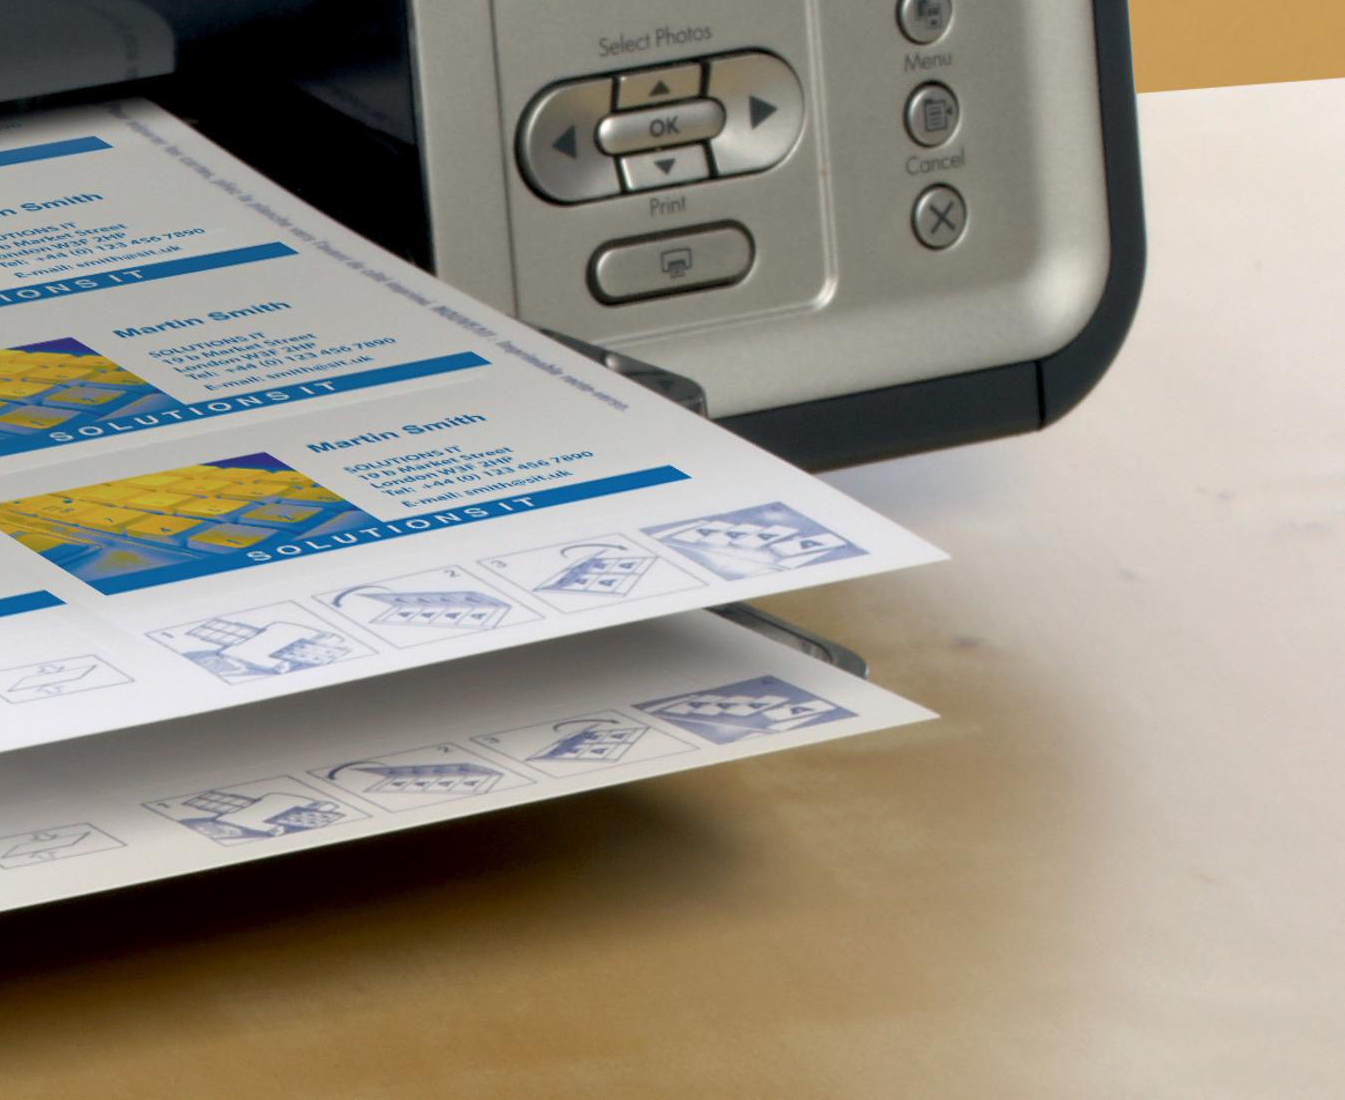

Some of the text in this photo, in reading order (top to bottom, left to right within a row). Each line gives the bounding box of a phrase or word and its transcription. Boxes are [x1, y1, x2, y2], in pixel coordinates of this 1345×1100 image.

[598, 25, 712, 57] Select Photos
[904, 53, 953, 72] Menu
[649, 116, 680, 137] OK
[905, 147, 966, 175] Cancel
[20, 194, 104, 212] Smith
[649, 196, 687, 216] Print
[12, 233, 74, 247] Market
[74, 224, 127, 236] Street
[14, 245, 183, 279] E-mail: smith@sit.uk
[108, 269, 143, 282] IT
[113, 302, 291, 338] Martin Smith
[148, 332, 265, 358] SOLUTIONS IT
[162, 357, 184, 365] 19
[201, 343, 263, 358] Market
[263, 333, 317, 347] Street
[173, 342, 315, 373] London W3F 2HP
[185, 338, 396, 380] Tel: +44 (0) 123 456 7890
[204, 355, 374, 391] E-mail: smith@sit.uk
[49, 381, 335, 441] SOLUTIONS IT
[307, 415, 486, 453] Martin Smith
[344, 446, 461, 473] SOLUTIONS IT
[358, 473, 381, 481] 19
[397, 457, 459, 473] Market
[459, 447, 513, 461] Street
[370, 456, 512, 489] London W3F 2HP
[382, 451, 593, 496] Tel: +44 (0) 123 456 7890
[401, 470, 572, 508] E-mail: smith@sit.uk
[247, 497, 534, 561] SOLUTIONS IT
